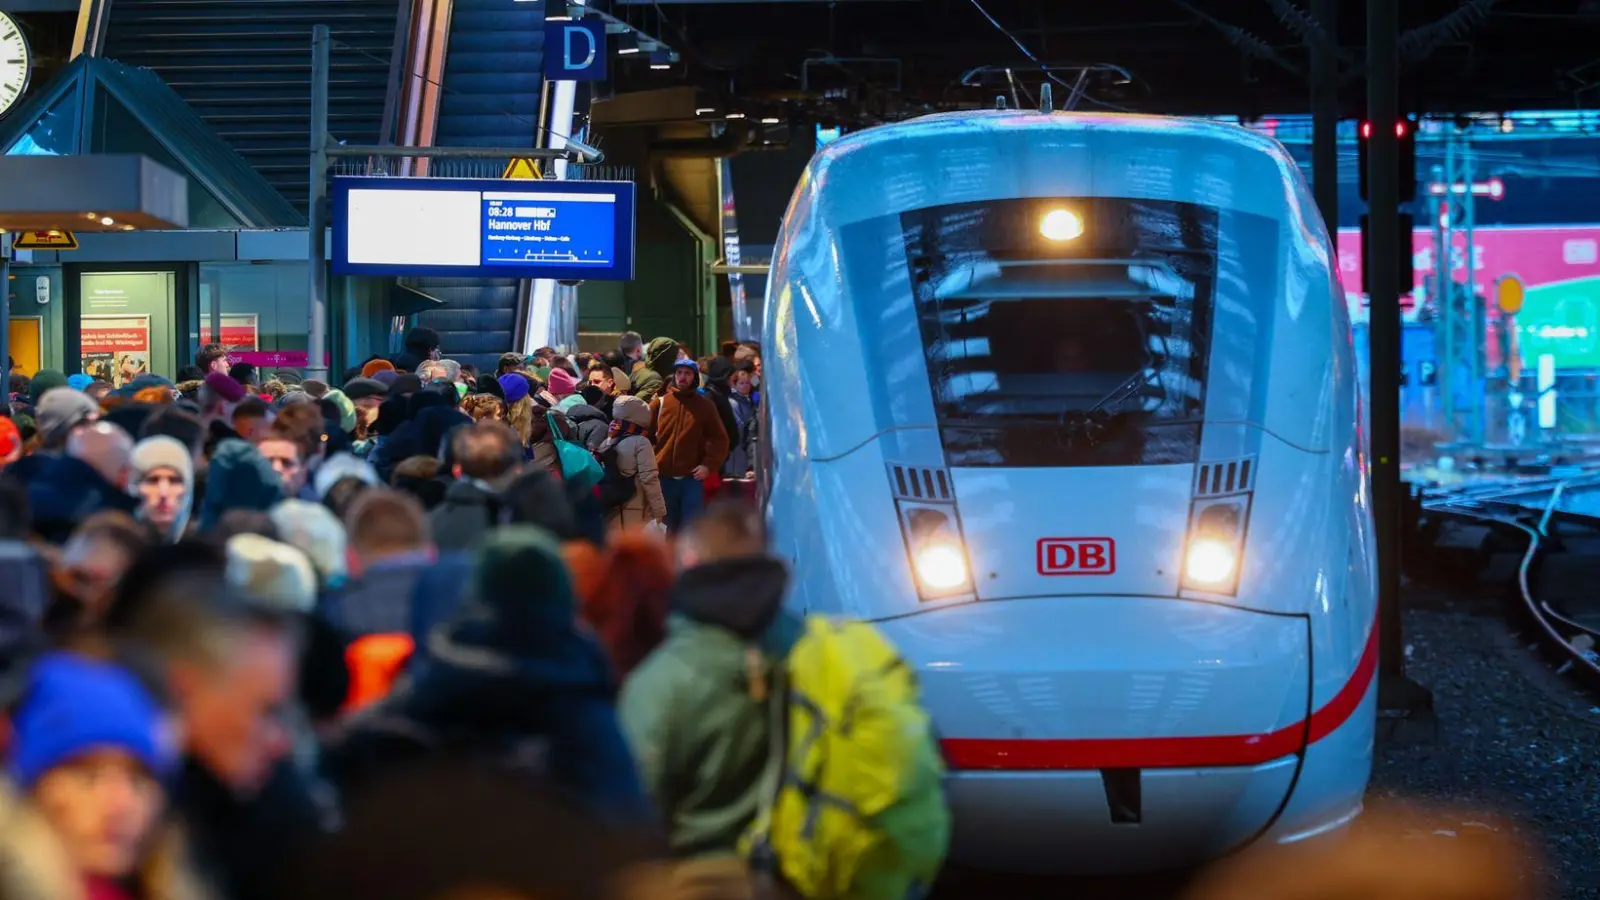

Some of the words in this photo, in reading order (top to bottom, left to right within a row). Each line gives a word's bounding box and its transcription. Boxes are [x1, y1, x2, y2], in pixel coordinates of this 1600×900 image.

[563, 26, 596, 70] D
[488, 207, 513, 216] 08:28
[488, 219, 532, 230] Hannover
[534, 220, 551, 231] Hbf
[1047, 543, 1106, 569] DB
